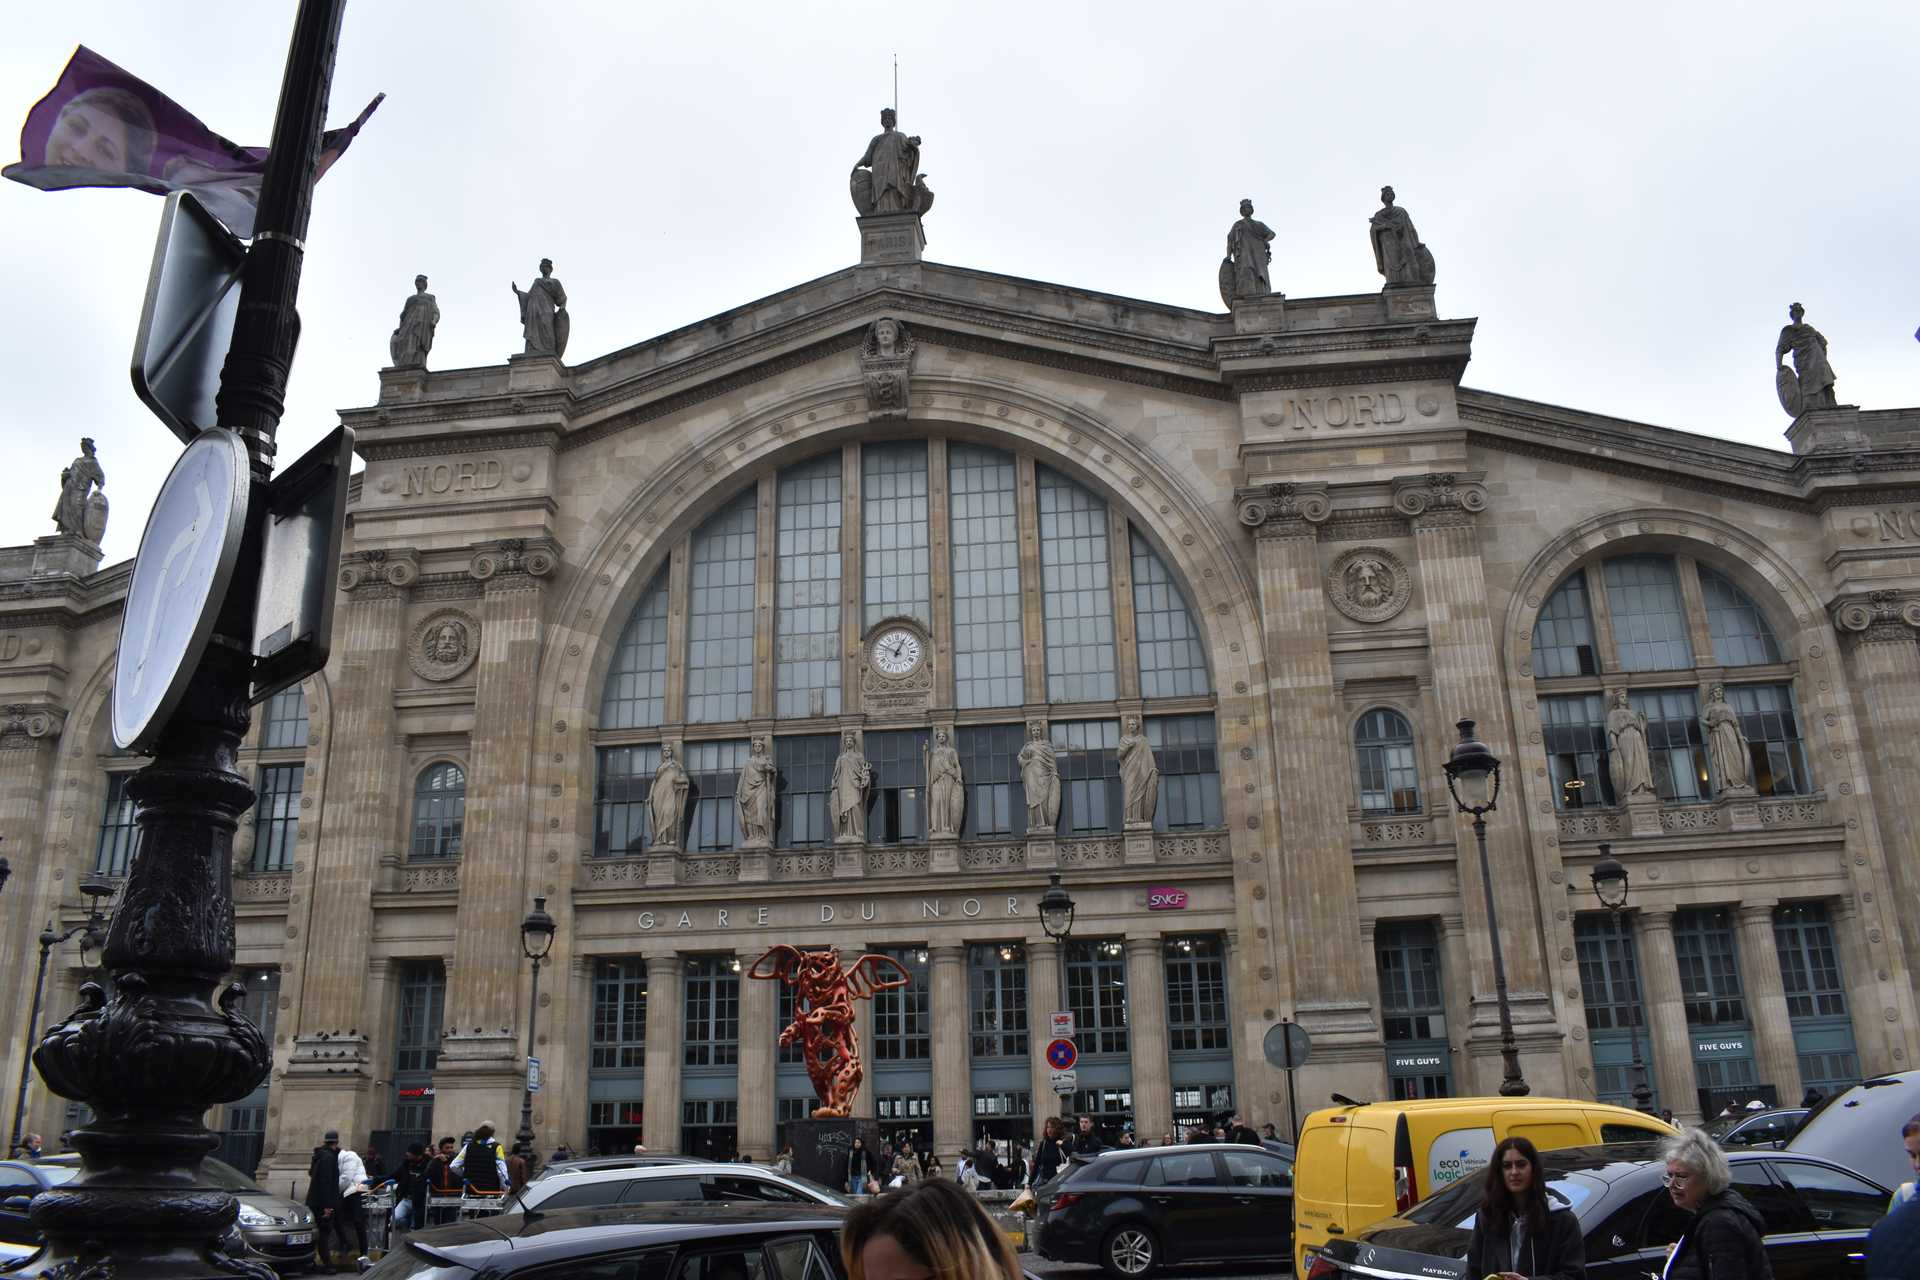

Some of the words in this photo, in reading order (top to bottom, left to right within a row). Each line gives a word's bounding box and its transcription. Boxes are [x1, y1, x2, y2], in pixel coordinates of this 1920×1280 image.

[1289, 394, 1405, 430] NORD
[400, 460, 503, 496] NORD
[1150, 893, 1185, 906] SNCF
[638, 907, 769, 929] GARE
[820, 902, 875, 922] DU
[923, 896, 1020, 918] NOR
[1719, 1042, 1743, 1050] GUYS
[1396, 1058, 1415, 1066] FIVE
[1416, 1057, 1440, 1065] GUYS
[1439, 1159, 1460, 1169] eco
[1433, 1168, 1461, 1182] logic
[1422, 1267, 1458, 1277] MAYBACH
